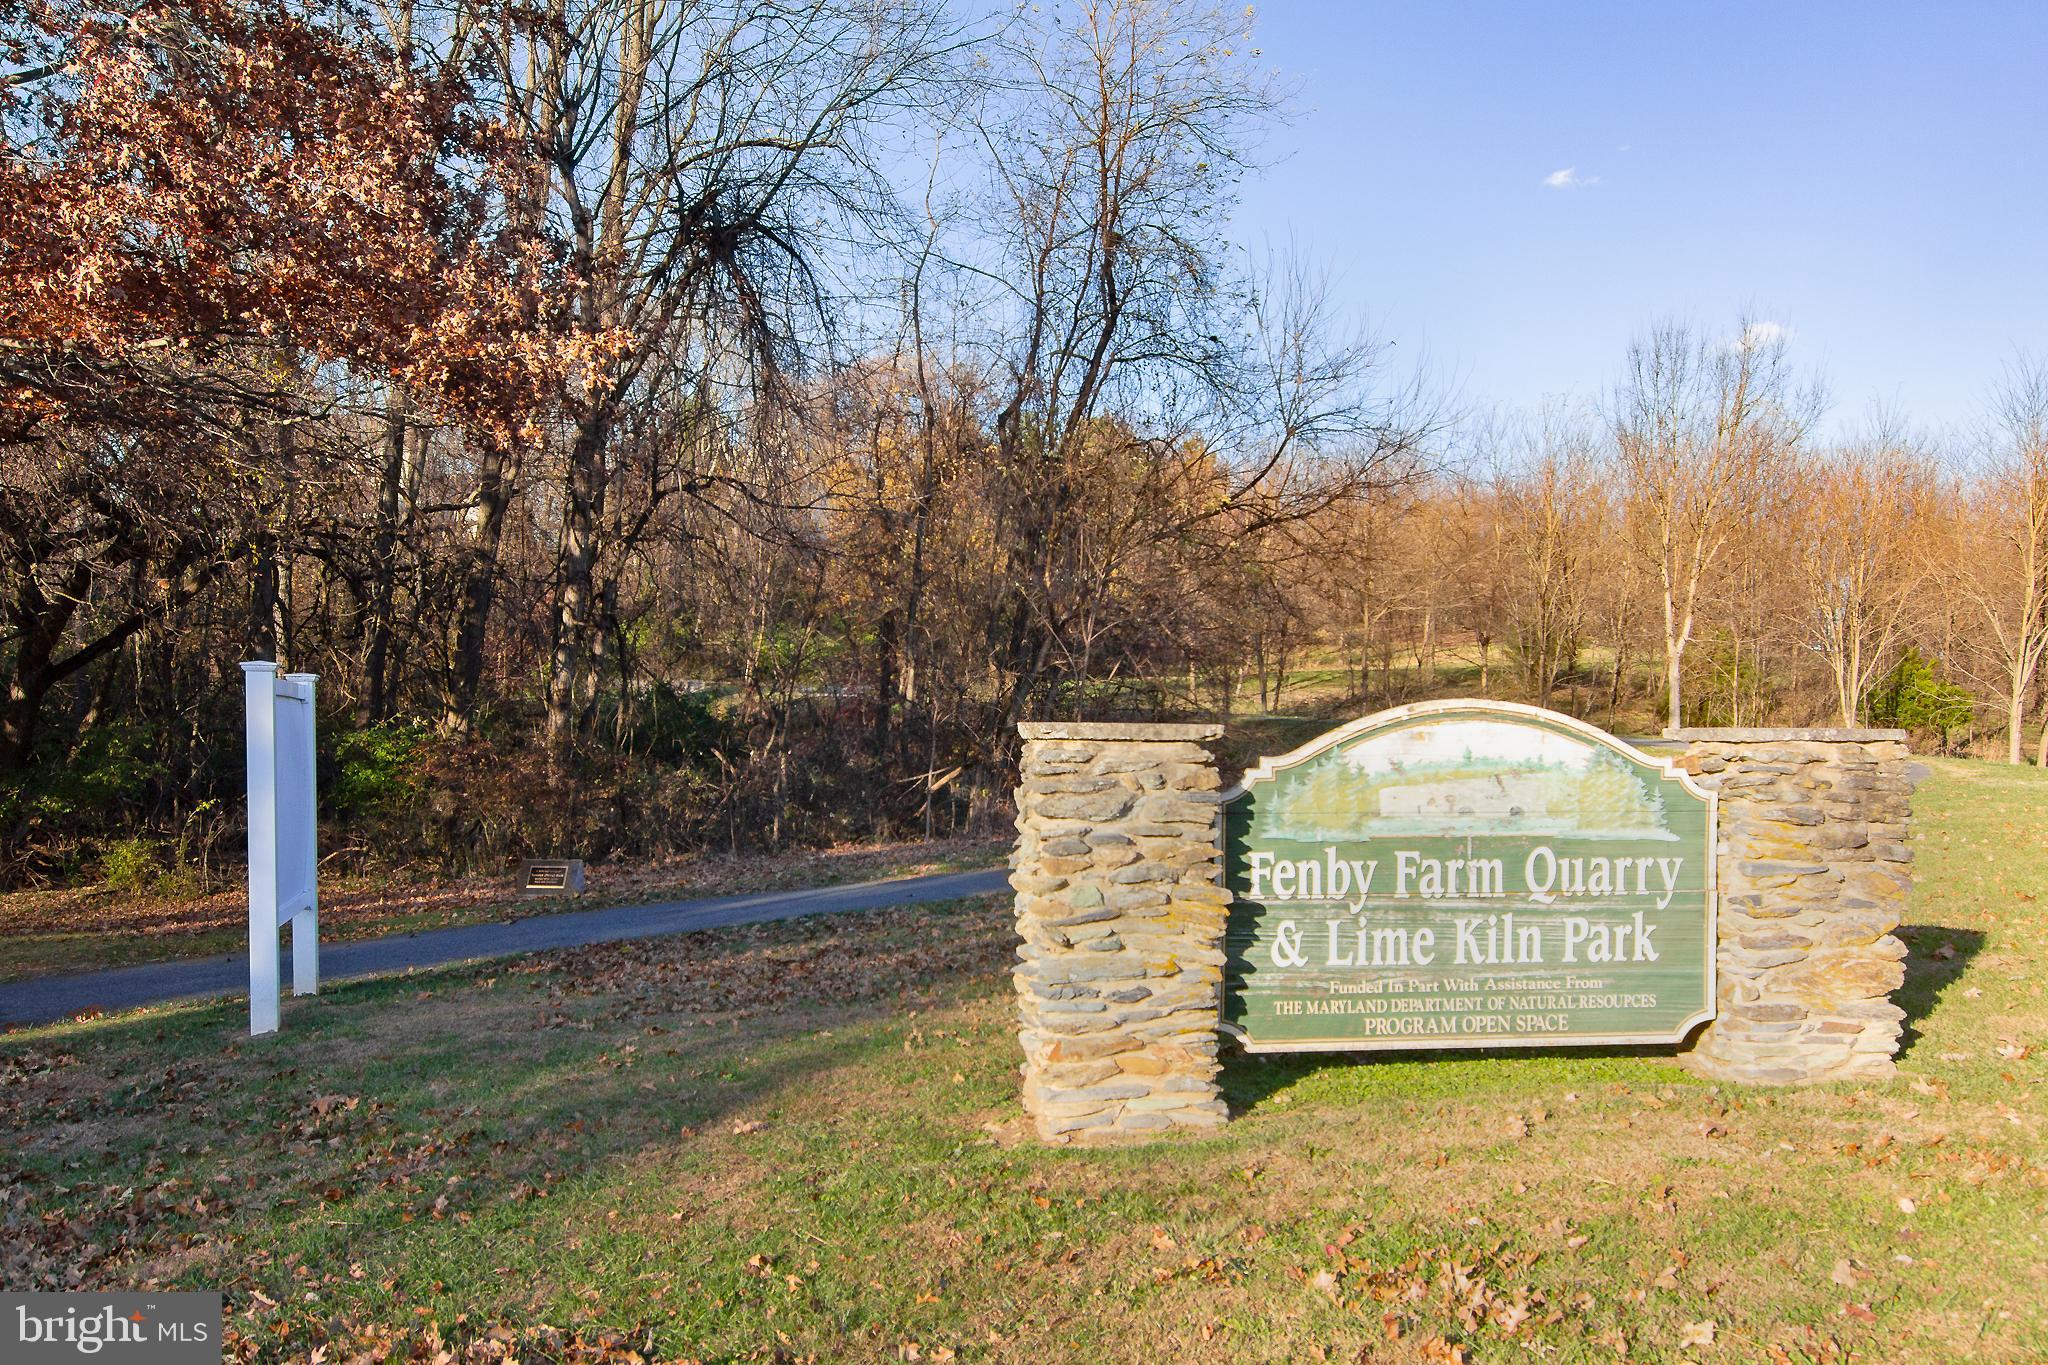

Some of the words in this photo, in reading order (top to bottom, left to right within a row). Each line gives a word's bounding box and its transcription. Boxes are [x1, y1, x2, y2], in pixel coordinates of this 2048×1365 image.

[1247, 845, 1379, 915] Fenby
[1394, 850, 1506, 898] Farm
[1525, 846, 1684, 910] Quarry
[1270, 919, 1309, 968] &
[1326, 916, 1436, 966] Lime
[1454, 912, 1545, 965] Kiln
[1562, 910, 1660, 962] Park
[1329, 980, 1383, 994] Funded
[1388, 980, 1404, 993] In
[1408, 979, 1440, 993] Part
[1444, 978, 1479, 993] With
[1485, 977, 1561, 991] Assistance
[1566, 976, 1604, 990] From
[1273, 1000, 1303, 1015] THE
[1306, 999, 1388, 1015] MARYLAND
[1391, 997, 1483, 1012] DEPARTMENT
[1488, 996, 1507, 1011] OF
[1510, 995, 1576, 1010] NATURAL
[1579, 993, 1657, 1008] RESOURCES
[1365, 1016, 1457, 1035] PROGRAM
[1462, 1014, 1512, 1033] OPEN
[1516, 1013, 1569, 1032] SPACE
